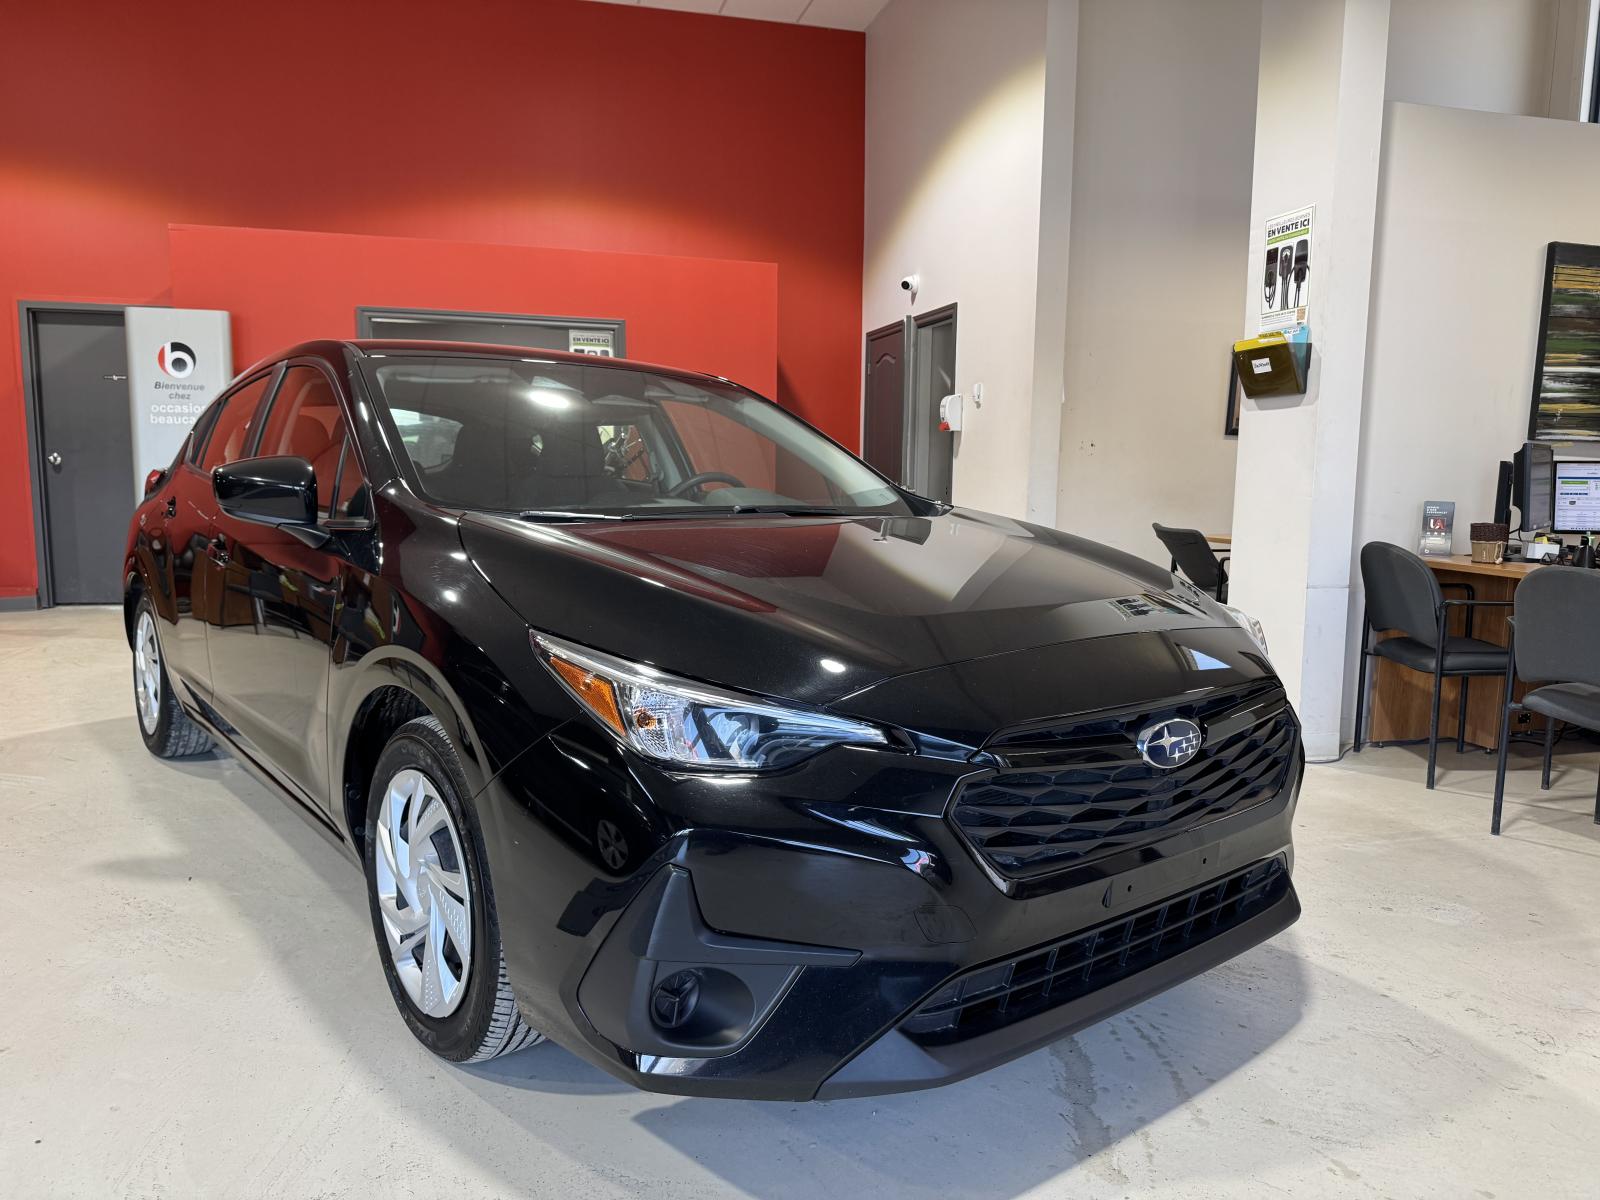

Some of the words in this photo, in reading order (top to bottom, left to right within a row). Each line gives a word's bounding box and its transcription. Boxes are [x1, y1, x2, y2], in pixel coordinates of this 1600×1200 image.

[1268, 229, 1276, 238] EN
[1277, 221, 1299, 234] VENTE
[1300, 218, 1309, 228] ICI
[154, 381, 206, 391] Bienvenue
[168, 391, 191, 400] chez
[150, 413, 196, 425] beauca
